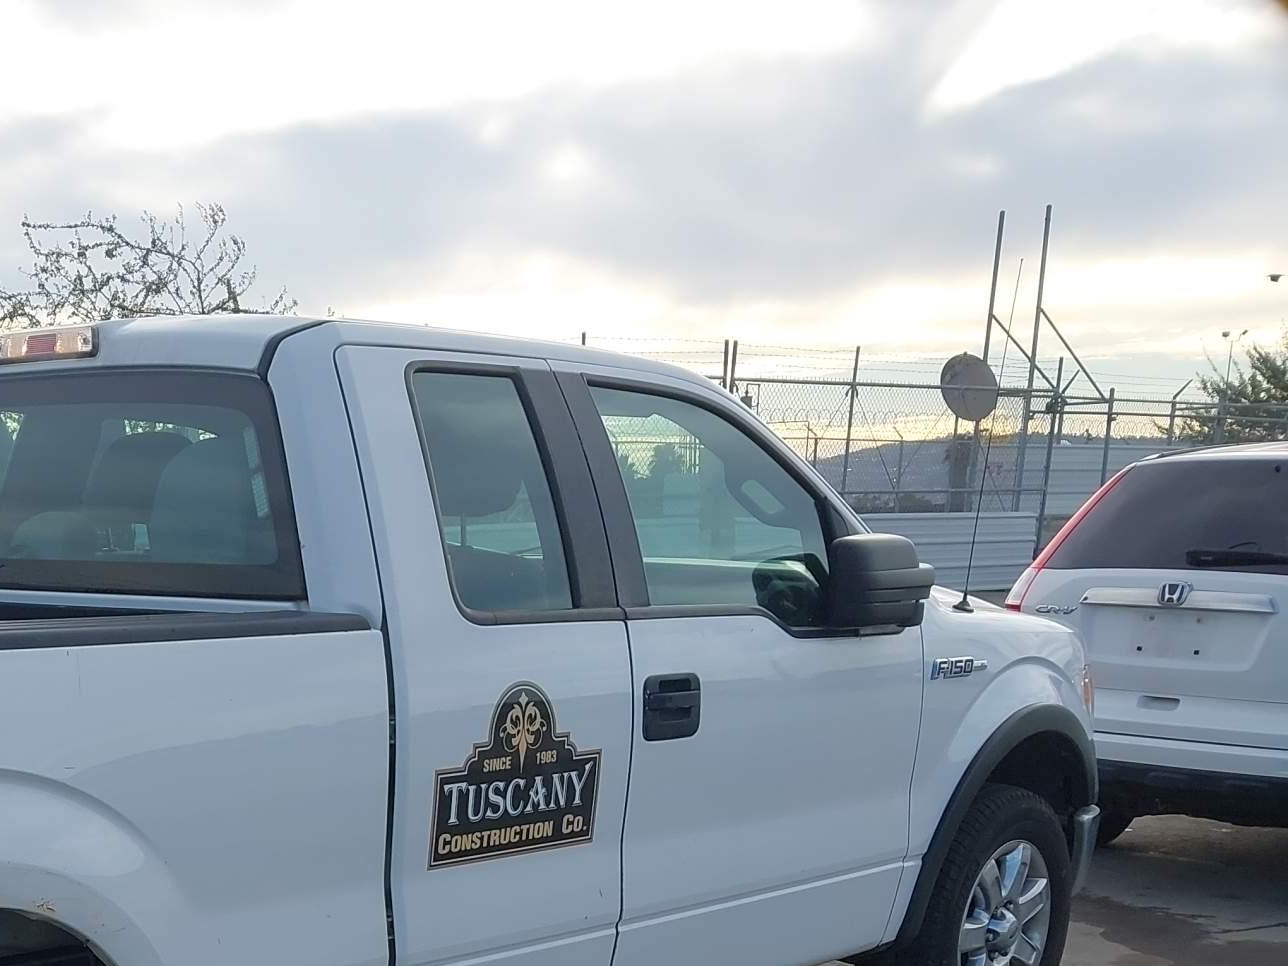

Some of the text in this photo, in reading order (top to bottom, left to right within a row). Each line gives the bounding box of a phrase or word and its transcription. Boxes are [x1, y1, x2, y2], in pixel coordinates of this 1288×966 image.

[483, 750, 557, 773] SINCE 1983
[443, 760, 594, 826] TUSCANY
